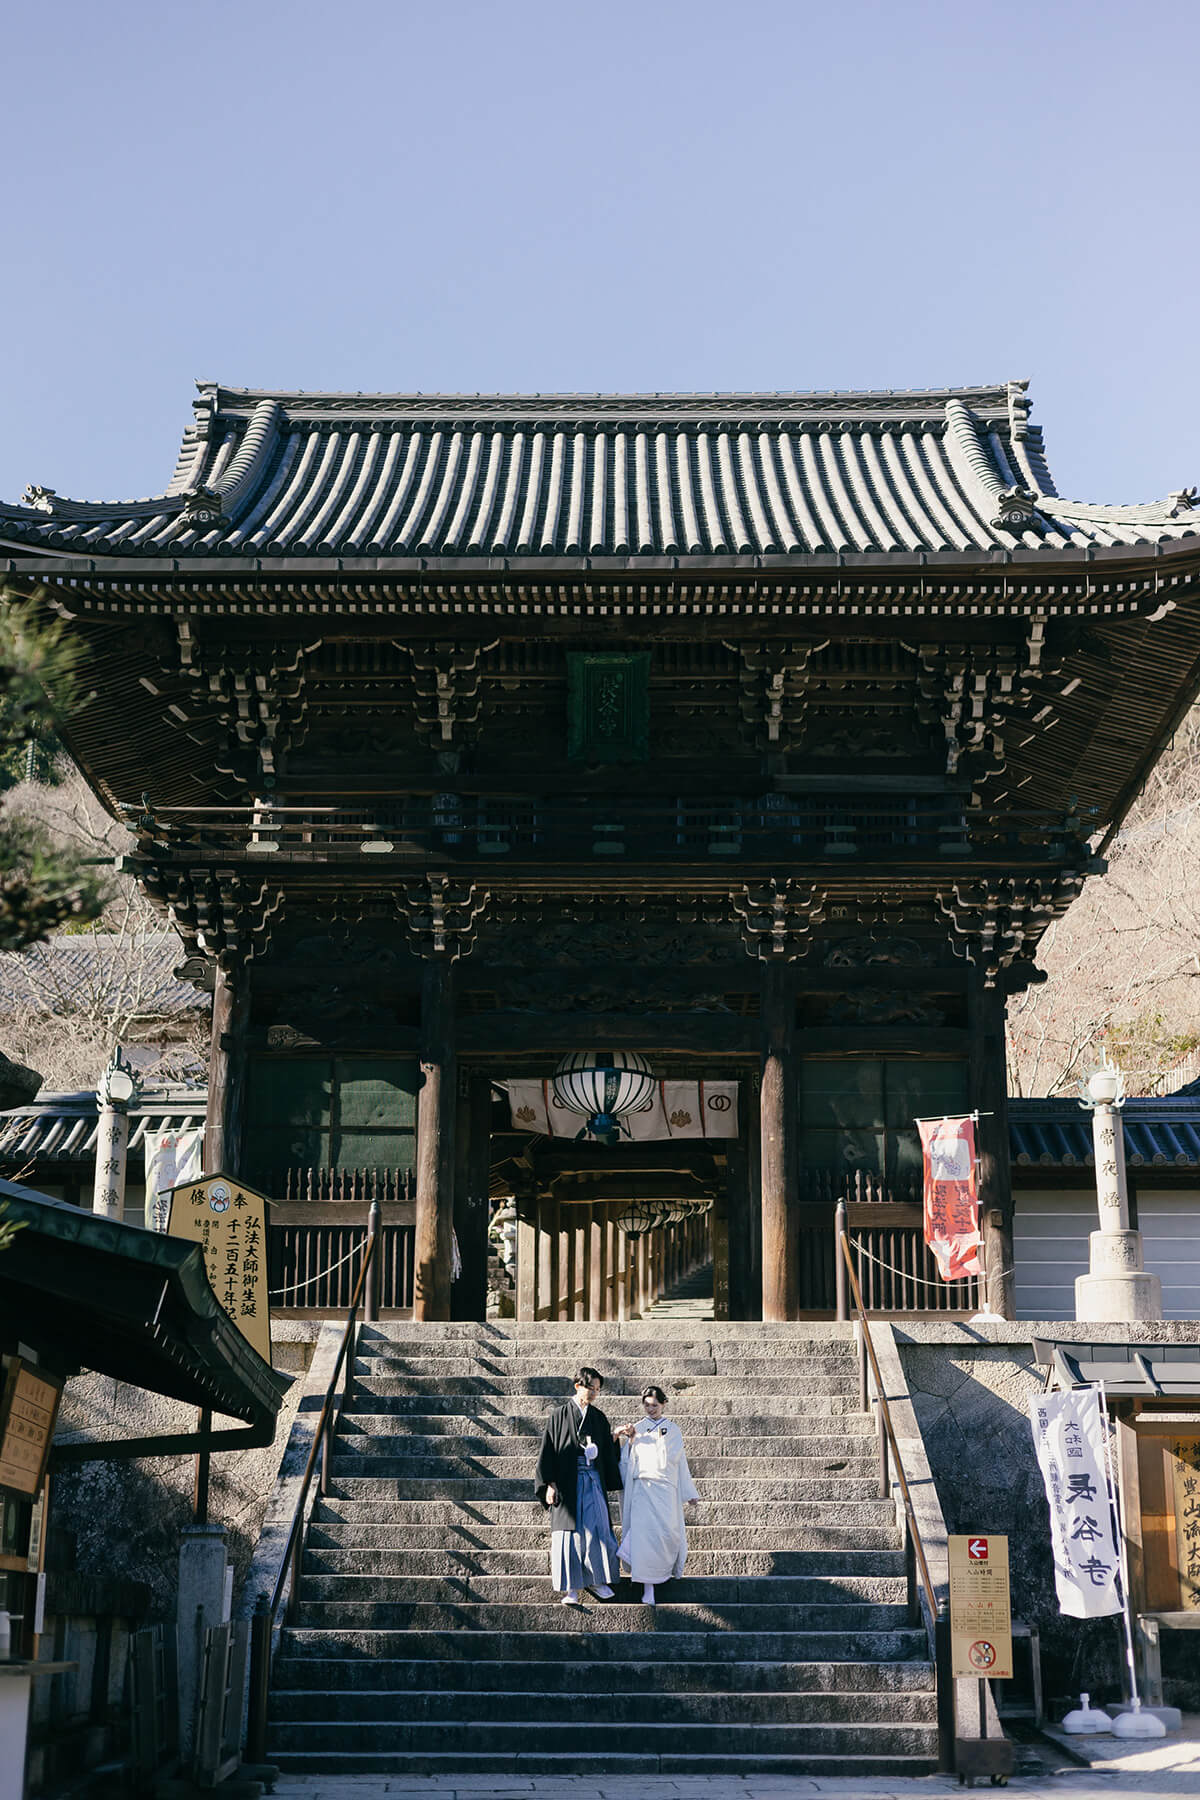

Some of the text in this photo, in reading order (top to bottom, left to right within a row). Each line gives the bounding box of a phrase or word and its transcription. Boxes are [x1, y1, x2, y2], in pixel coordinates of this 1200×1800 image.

[240, 1215, 262, 1318] 弘法大師御生誕
[1065, 1473, 1112, 1587] 長谷寺
